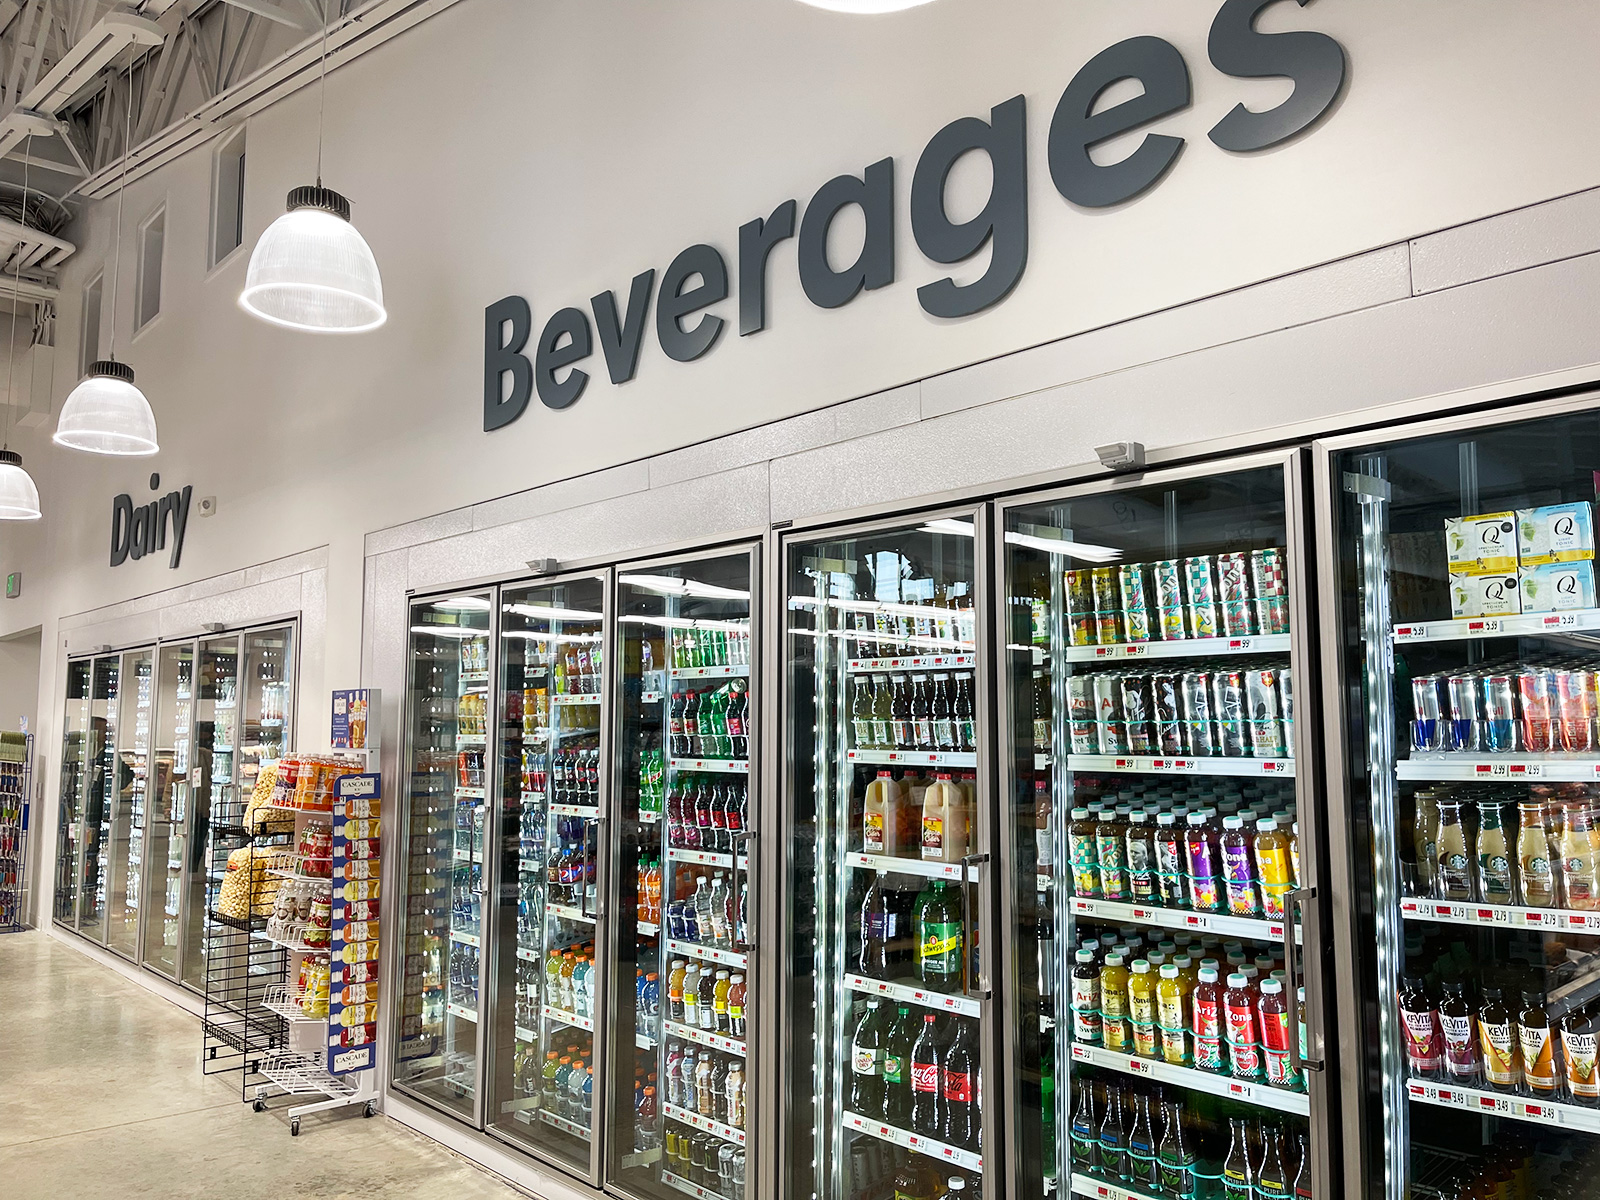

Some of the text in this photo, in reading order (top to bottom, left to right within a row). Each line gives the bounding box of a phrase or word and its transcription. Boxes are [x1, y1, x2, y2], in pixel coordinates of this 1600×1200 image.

[484, 0, 1350, 432] Beverages
[110, 473, 192, 569] Dairy
[1554, 516, 1574, 536] Q
[1482, 526, 1500, 545] Q
[1485, 581, 1504, 600] Q
[1556, 575, 1577, 595] Q
[1406, 1014, 1431, 1025] KEVITA
[1443, 1018, 1468, 1029] KEVITA
[1488, 1026, 1515, 1037] KEVITA
[1566, 1035, 1597, 1047] KEVITA
[335, 1051, 367, 1064] CASCADE
